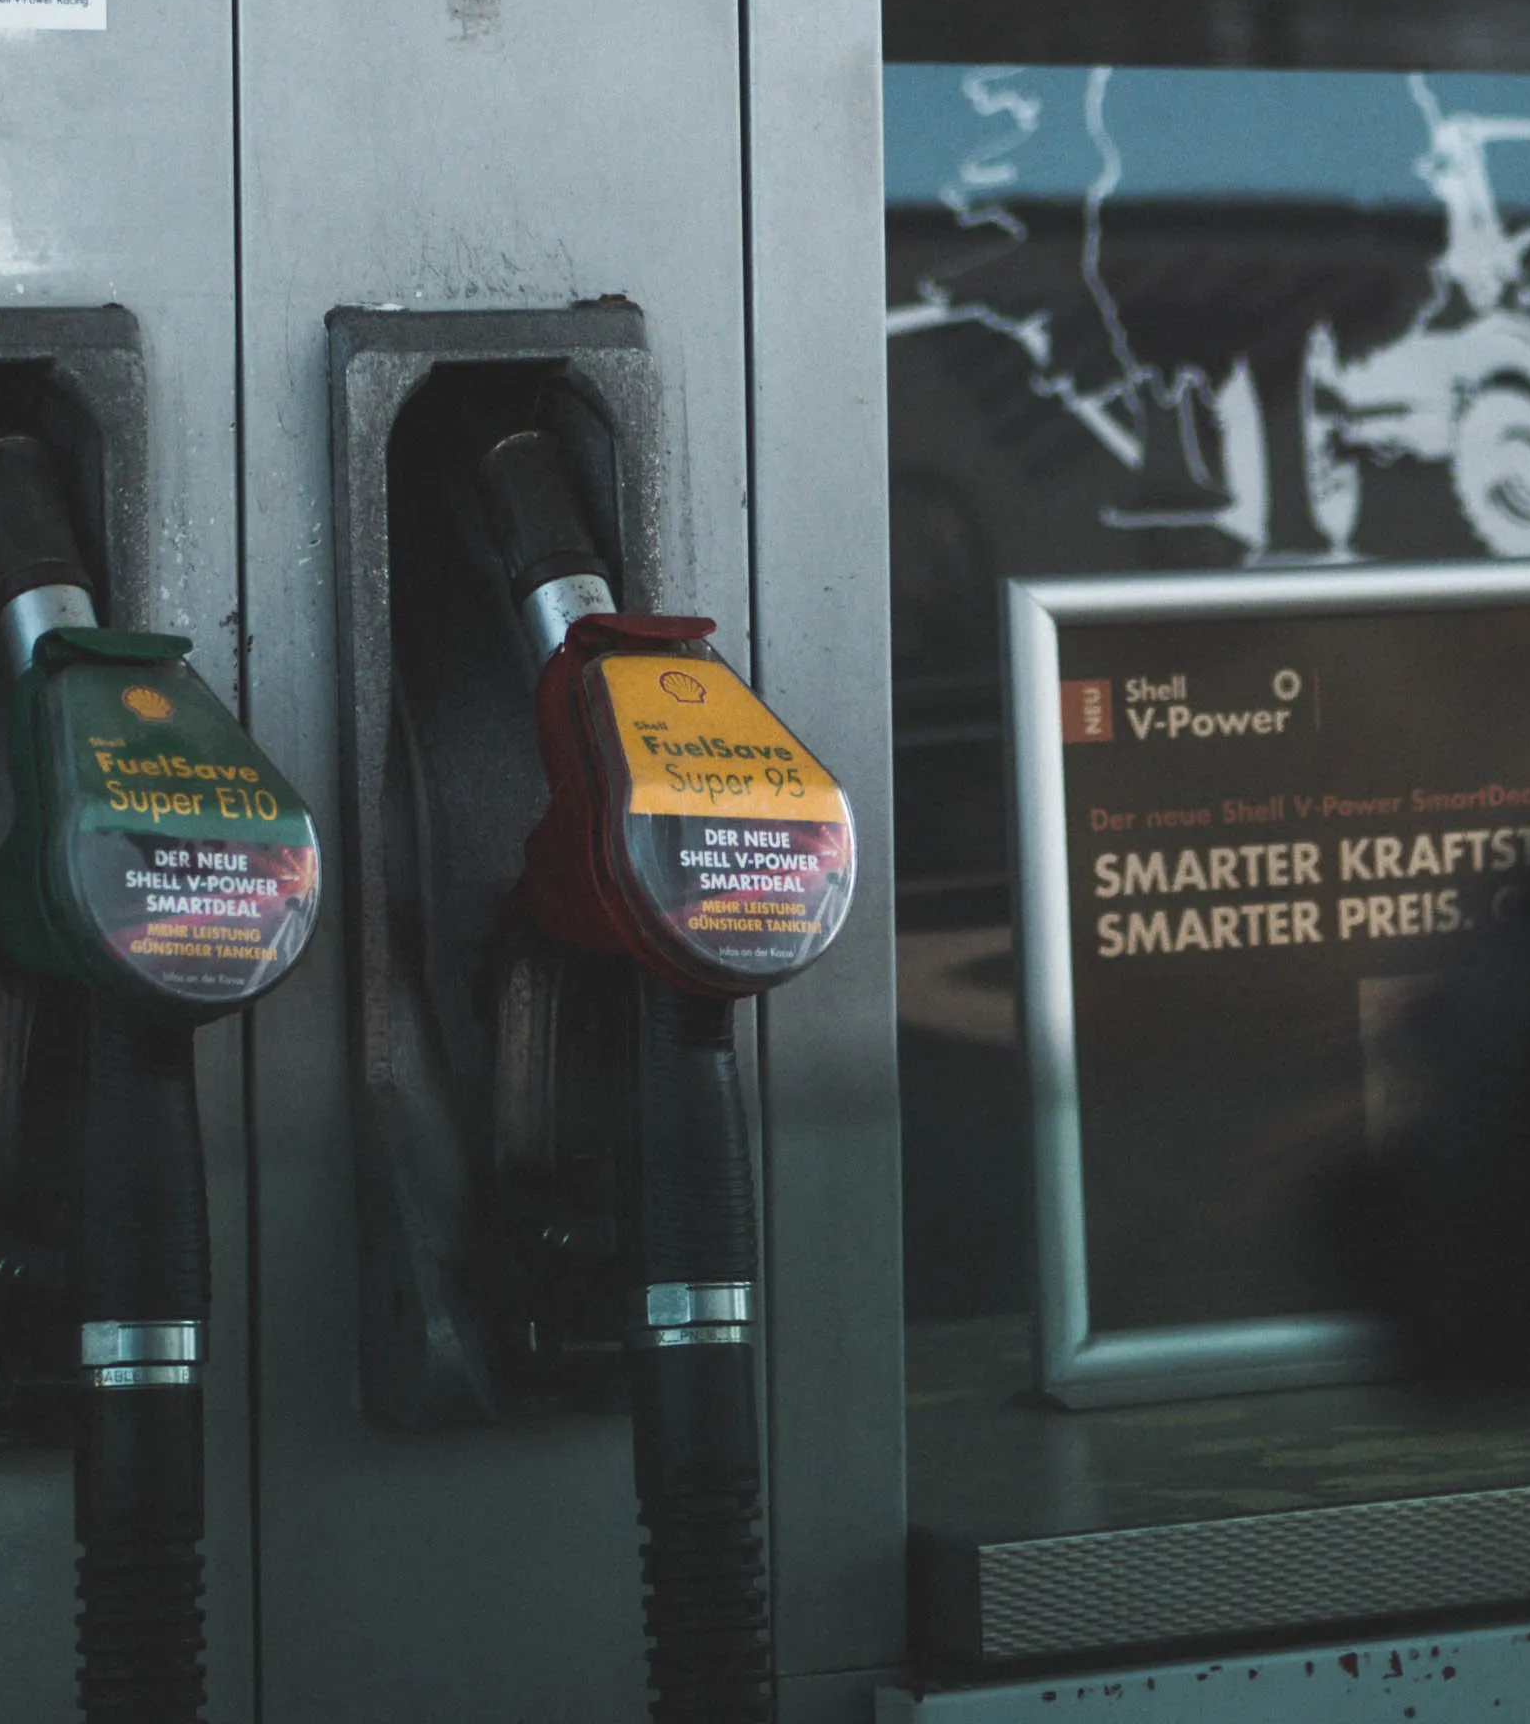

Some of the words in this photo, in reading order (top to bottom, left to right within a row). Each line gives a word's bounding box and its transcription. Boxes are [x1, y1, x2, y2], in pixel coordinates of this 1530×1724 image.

[1125, 675, 1187, 703] Shell
[1084, 688, 1104, 736] NEU
[1126, 704, 1291, 740] V-Power
[642, 736, 793, 761] FuelSave
[95, 752, 259, 783] FuelSave
[665, 764, 753, 804] Super
[765, 768, 805, 797] 95
[106, 780, 203, 823] Super
[215, 787, 277, 821] E10
[1090, 807, 1136, 832] Der
[1146, 808, 1211, 830] neue
[1222, 795, 1285, 823] Shell
[1294, 793, 1401, 820] V-Power
[705, 829, 738, 847] DER
[744, 830, 790, 849] NEUE
[155, 850, 191, 868] DER
[198, 852, 248, 873] NEUE
[680, 850, 729, 868] SHELL
[735, 852, 819, 872] V-POWER
[1094, 839, 1321, 899] SMARTER
[126, 871, 181, 891] SHELL
[186, 873, 278, 897] V-POWER
[700, 873, 805, 893] SMARTDEAL
[146, 895, 261, 918] SMARTDEAL
[701, 900, 740, 913] MEHR
[745, 901, 806, 916] LEISTUNG
[147, 924, 188, 937] MEHR
[193, 926, 261, 942] LEISTUNG
[689, 914, 763, 931] GÜNSTIGER
[1096, 900, 1323, 958] SMARTER
[130, 938, 211, 956] GÜNSTIGER
